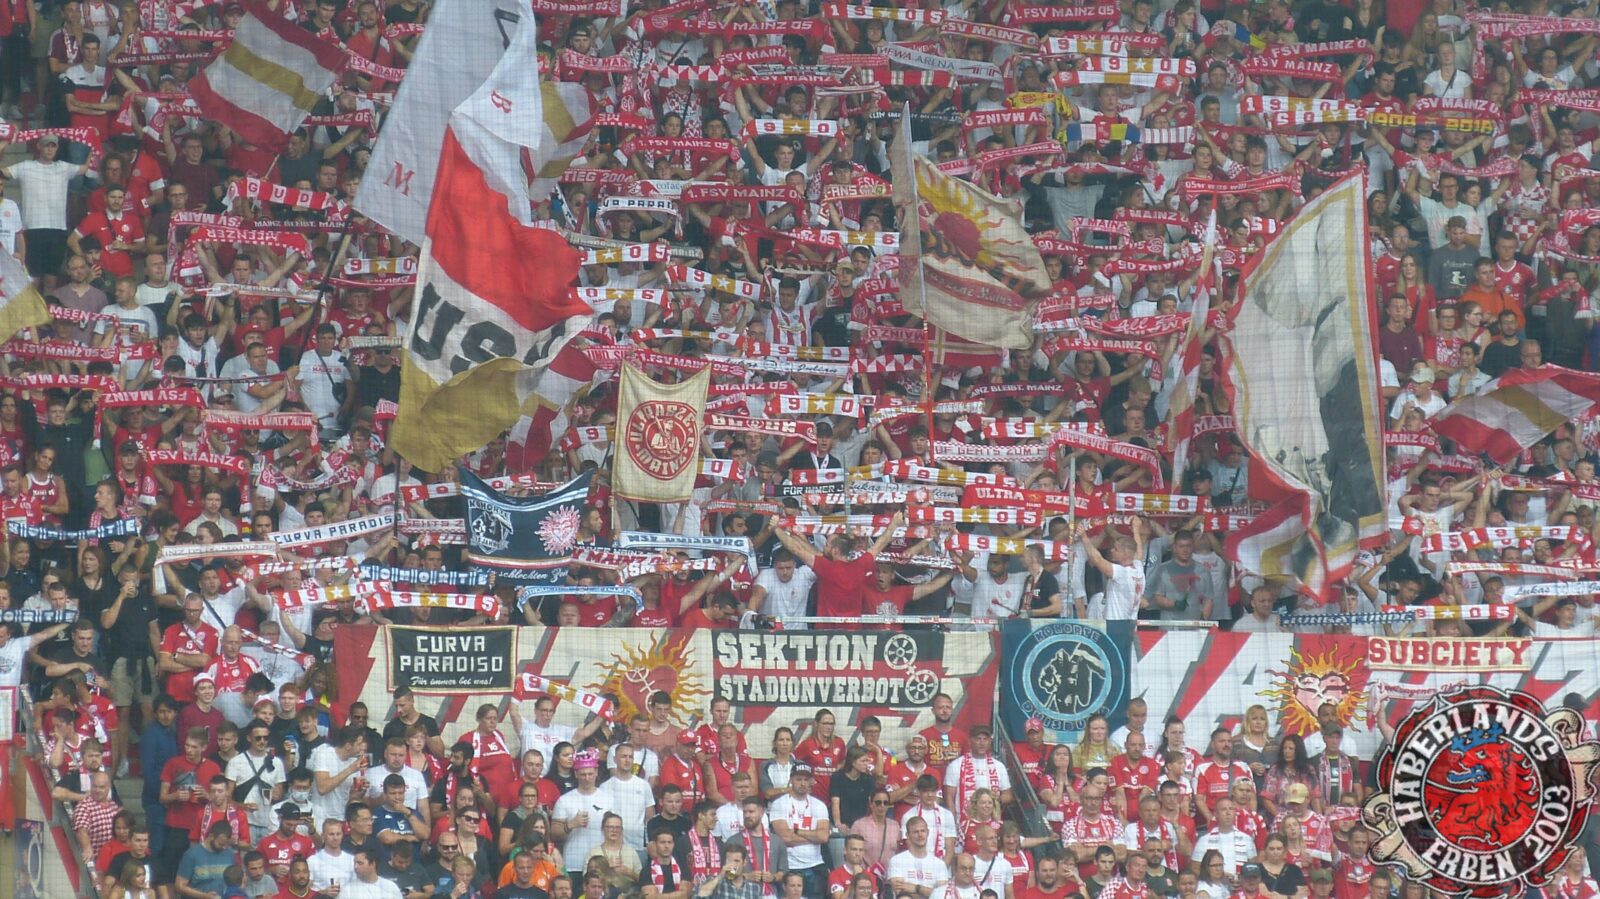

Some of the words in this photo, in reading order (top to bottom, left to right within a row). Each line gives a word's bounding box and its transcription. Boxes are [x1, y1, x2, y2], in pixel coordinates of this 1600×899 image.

[1023, 8, 1048, 18] FSV
[1052, 6, 1095, 18] MAINZ
[1098, 5, 1115, 16] 05
[697, 20, 728, 30] FSV
[733, 20, 787, 31] MAINZ
[791, 20, 814, 30] 05
[972, 28, 1023, 45] MAINZ
[1271, 45, 1300, 58] FSV
[1304, 39, 1354, 54] MAINZ
[915, 56, 956, 70] ARENA
[1284, 60, 1332, 74] MAINZ
[1443, 96, 1486, 110] MAINZ
[976, 112, 1023, 125] MAINZ
[648, 140, 670, 148] FSV
[672, 140, 710, 149] MAINZ
[714, 141, 730, 150] 05
[701, 188, 730, 198] FSV
[733, 187, 786, 198] MAINZ
[1129, 209, 1177, 222] MAINZ
[46, 344, 82, 359] MAINZ
[1102, 340, 1142, 351] MAINZ
[714, 383, 766, 391] MAINZ
[770, 380, 788, 391] 05
[104, 391, 154, 404] MAINZ
[150, 450, 177, 462] FSV
[183, 451, 234, 467] MAINZ
[975, 486, 1025, 501] ULTRA
[273, 530, 323, 545] CURVA
[361, 565, 489, 586] KOHORTE
[1033, 622, 1102, 643] KOHORTE
[416, 634, 486, 653] CURVA
[717, 632, 878, 671] SEKTION
[1369, 637, 1533, 666] SUBCIETY
[400, 655, 503, 673] PARADISO
[410, 676, 428, 687] Für
[430, 677, 457, 687] immer
[720, 674, 904, 704] STADIONVERBOT
